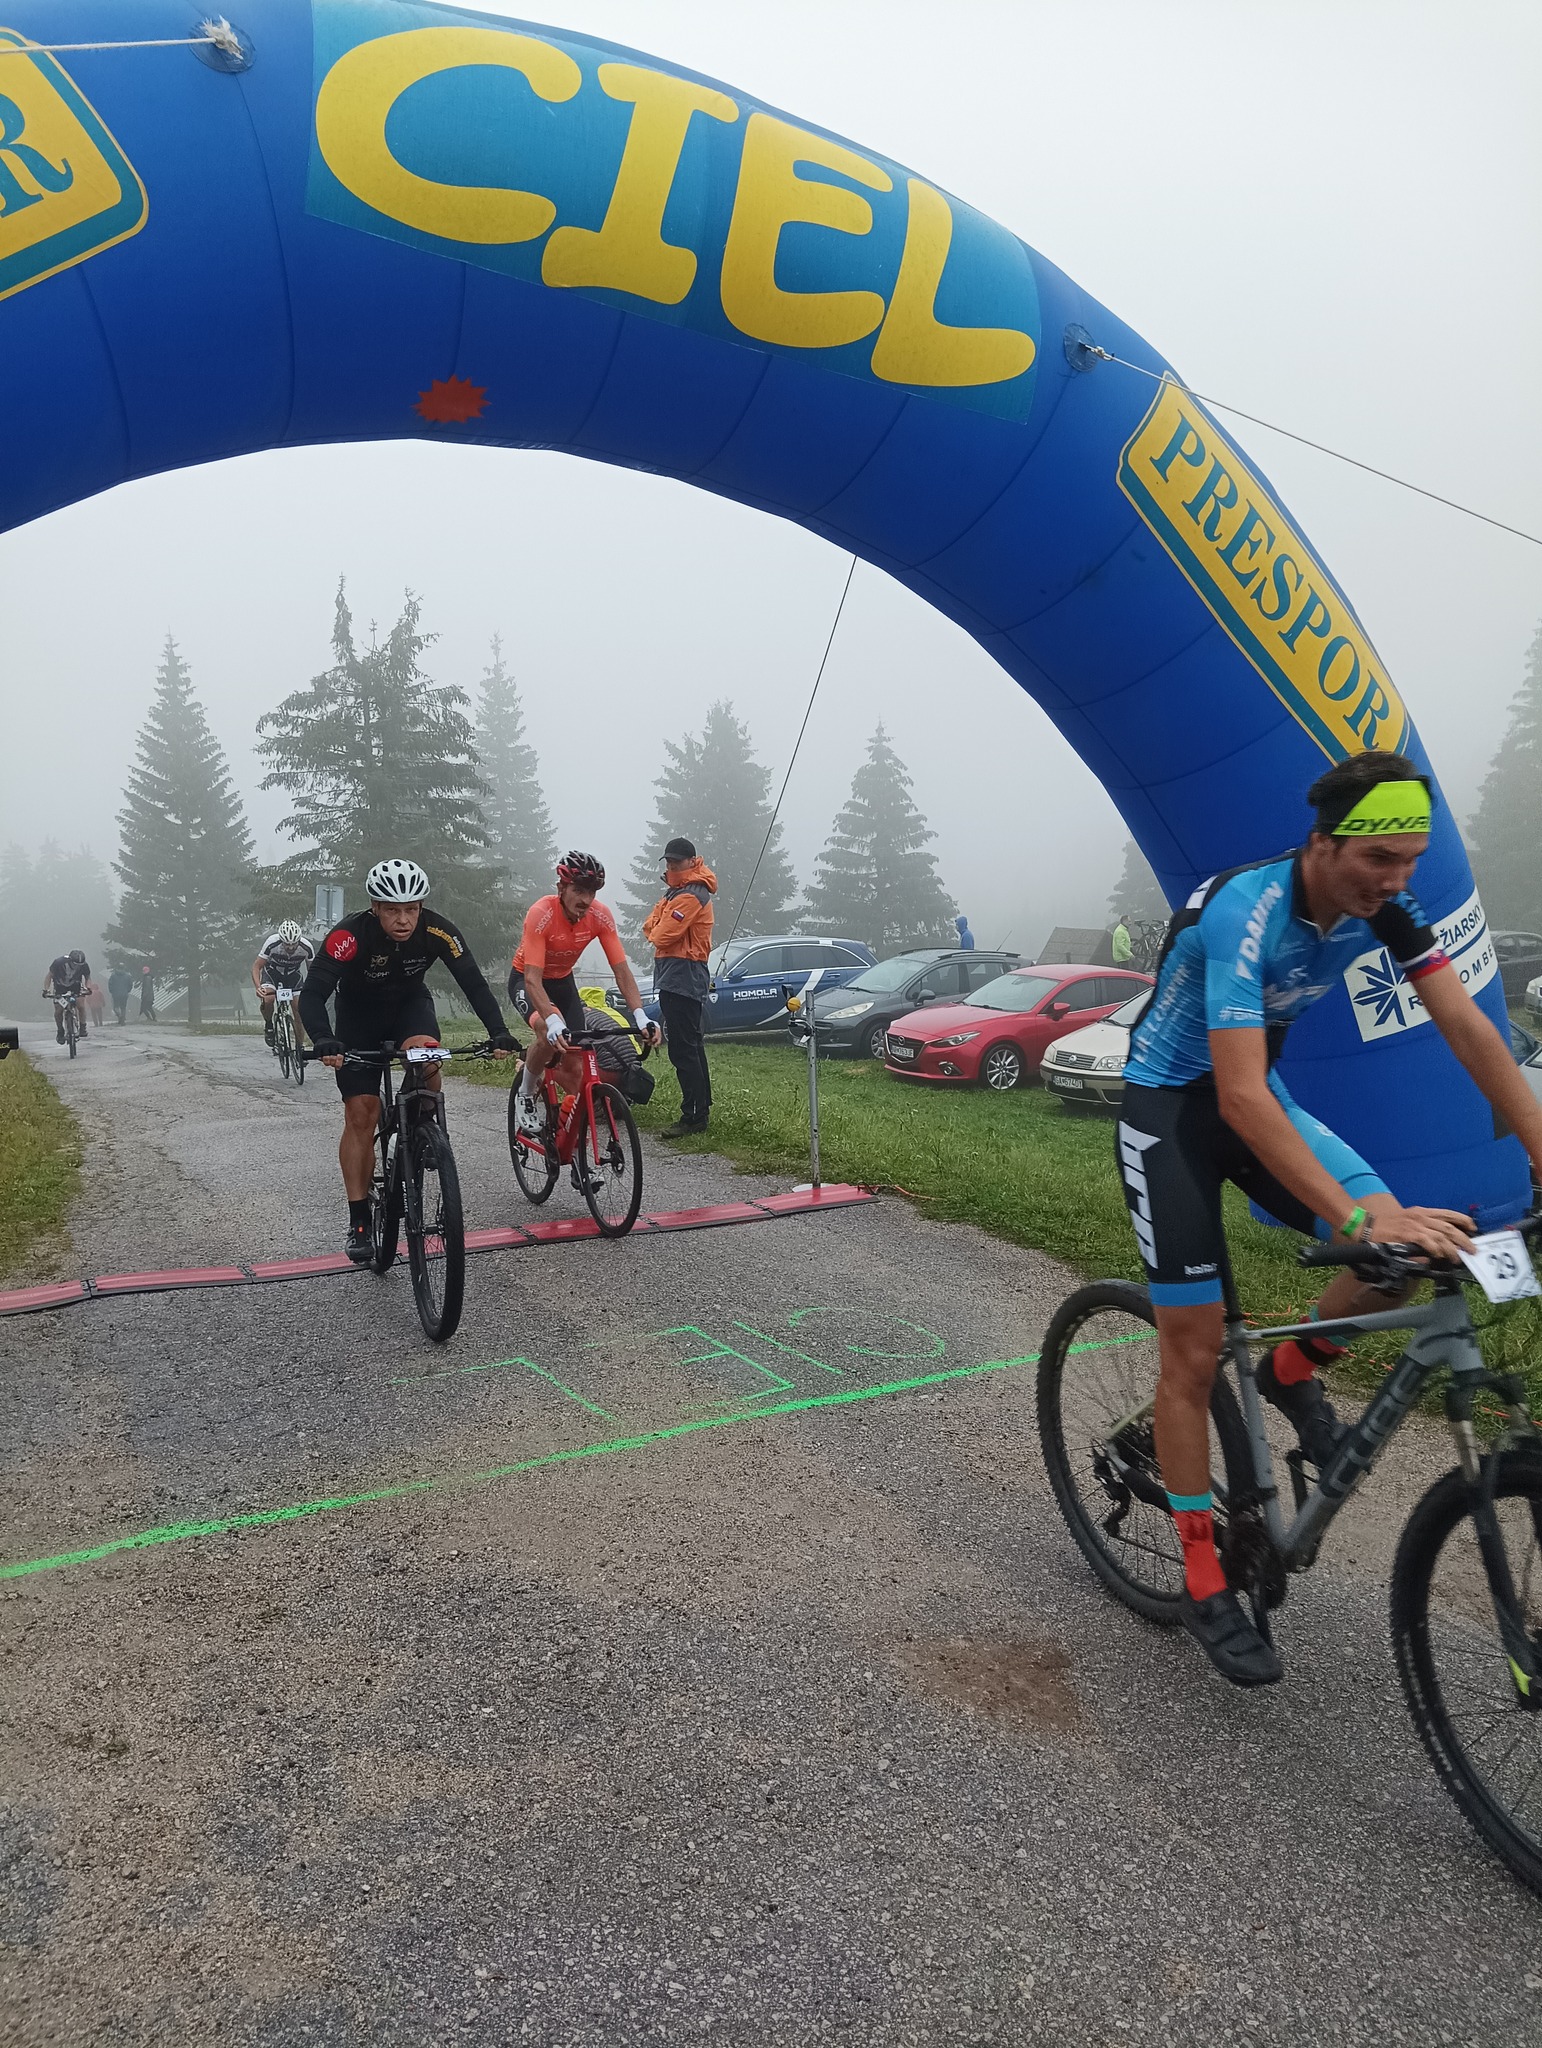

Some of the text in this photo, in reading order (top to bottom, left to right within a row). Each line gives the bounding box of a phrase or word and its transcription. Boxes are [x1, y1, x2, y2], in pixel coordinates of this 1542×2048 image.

[315, 26, 1036, 387] CIEL
[1149, 408, 1391, 750] PRESPOR
[733, 988, 777, 998] HOMOLA
